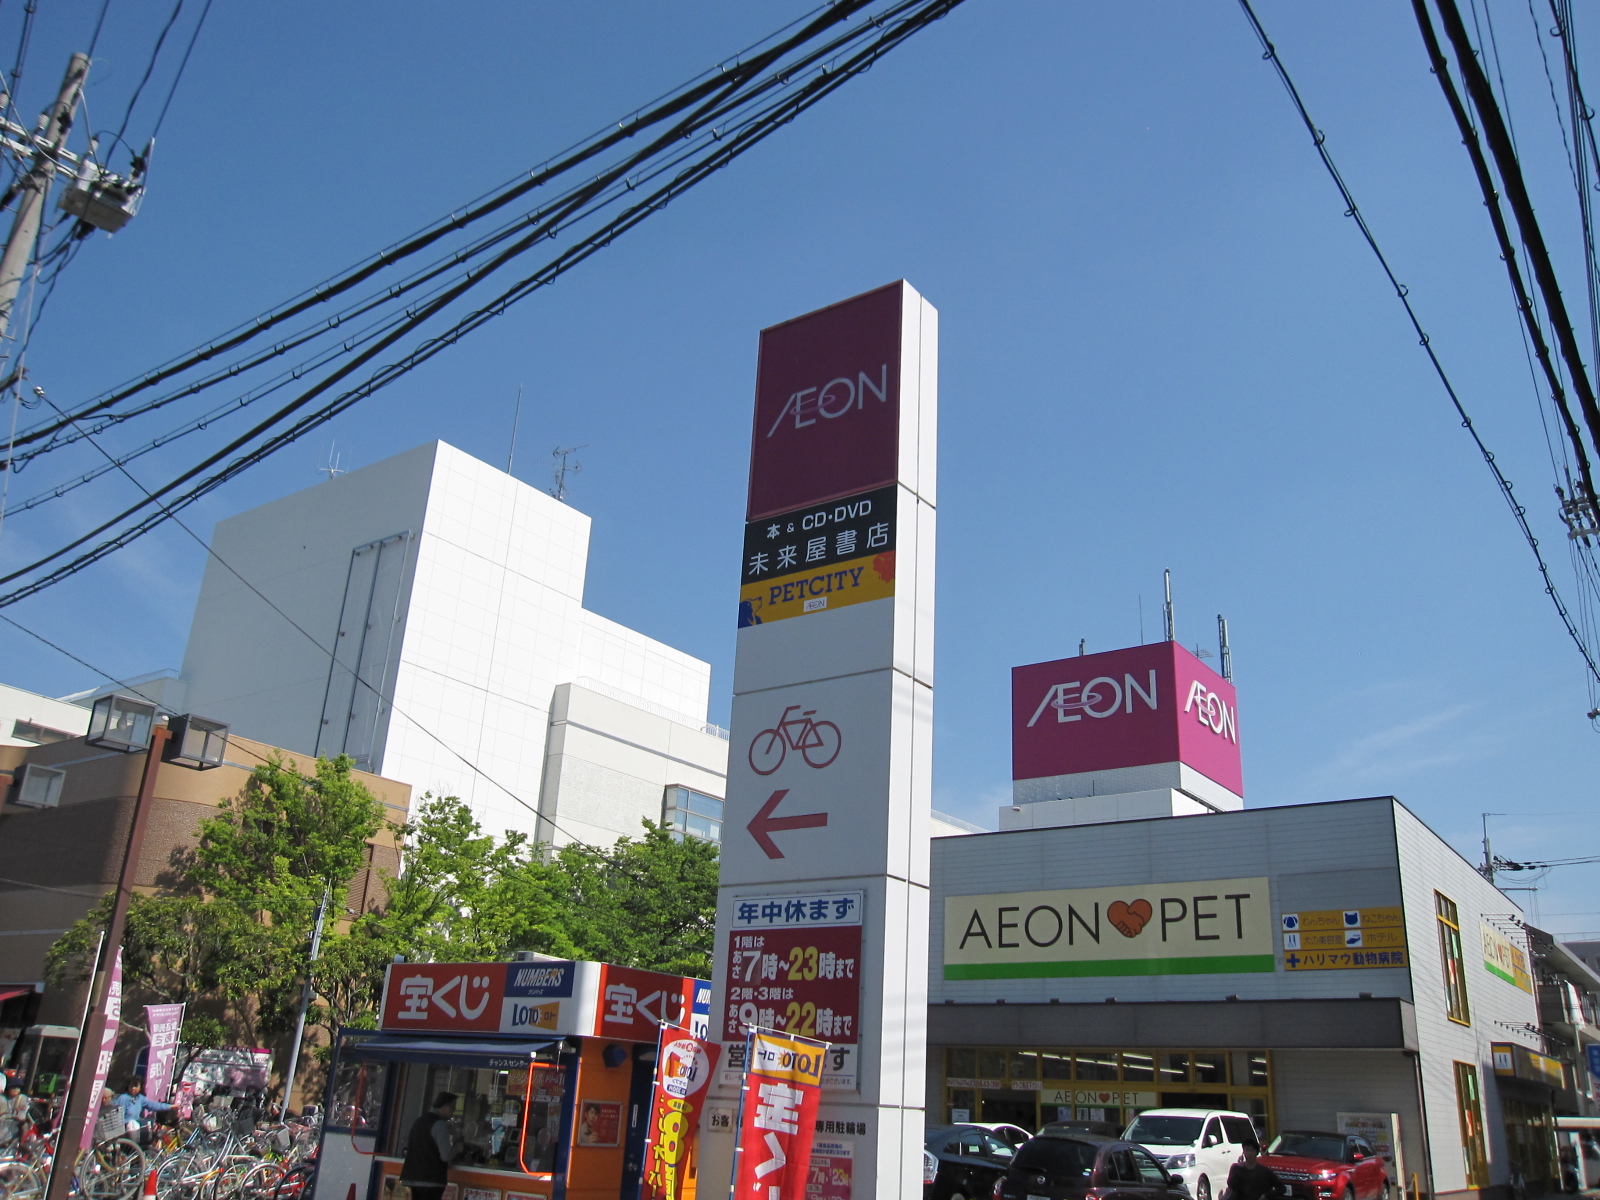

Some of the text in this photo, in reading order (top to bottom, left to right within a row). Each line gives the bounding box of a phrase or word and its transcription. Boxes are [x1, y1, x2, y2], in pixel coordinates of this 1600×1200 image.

[766, 523, 780, 539] 本
[786, 522, 794, 533] &
[748, 522, 890, 576] 未来屋書店
[768, 566, 865, 606] PETCITY
[737, 896, 855, 925] 年中休まず
[1302, 913, 1400, 927] わんちゃん ねこちゃん
[958, 893, 1251, 950] AEON PET
[734, 935, 765, 948] 1階は
[1303, 932, 1398, 946] 犬の美容室 ホテル
[1303, 950, 1404, 966] ハリマウ動物病院
[513, 967, 565, 988] NUMBERS
[398, 974, 490, 1020] 宝くじ
[730, 986, 794, 1000] 2階・3階は
[511, 1003, 539, 1026] LOTO
[604, 983, 686, 1026] 宝くじ
[1054, 1090, 1139, 1106] AEON PET
